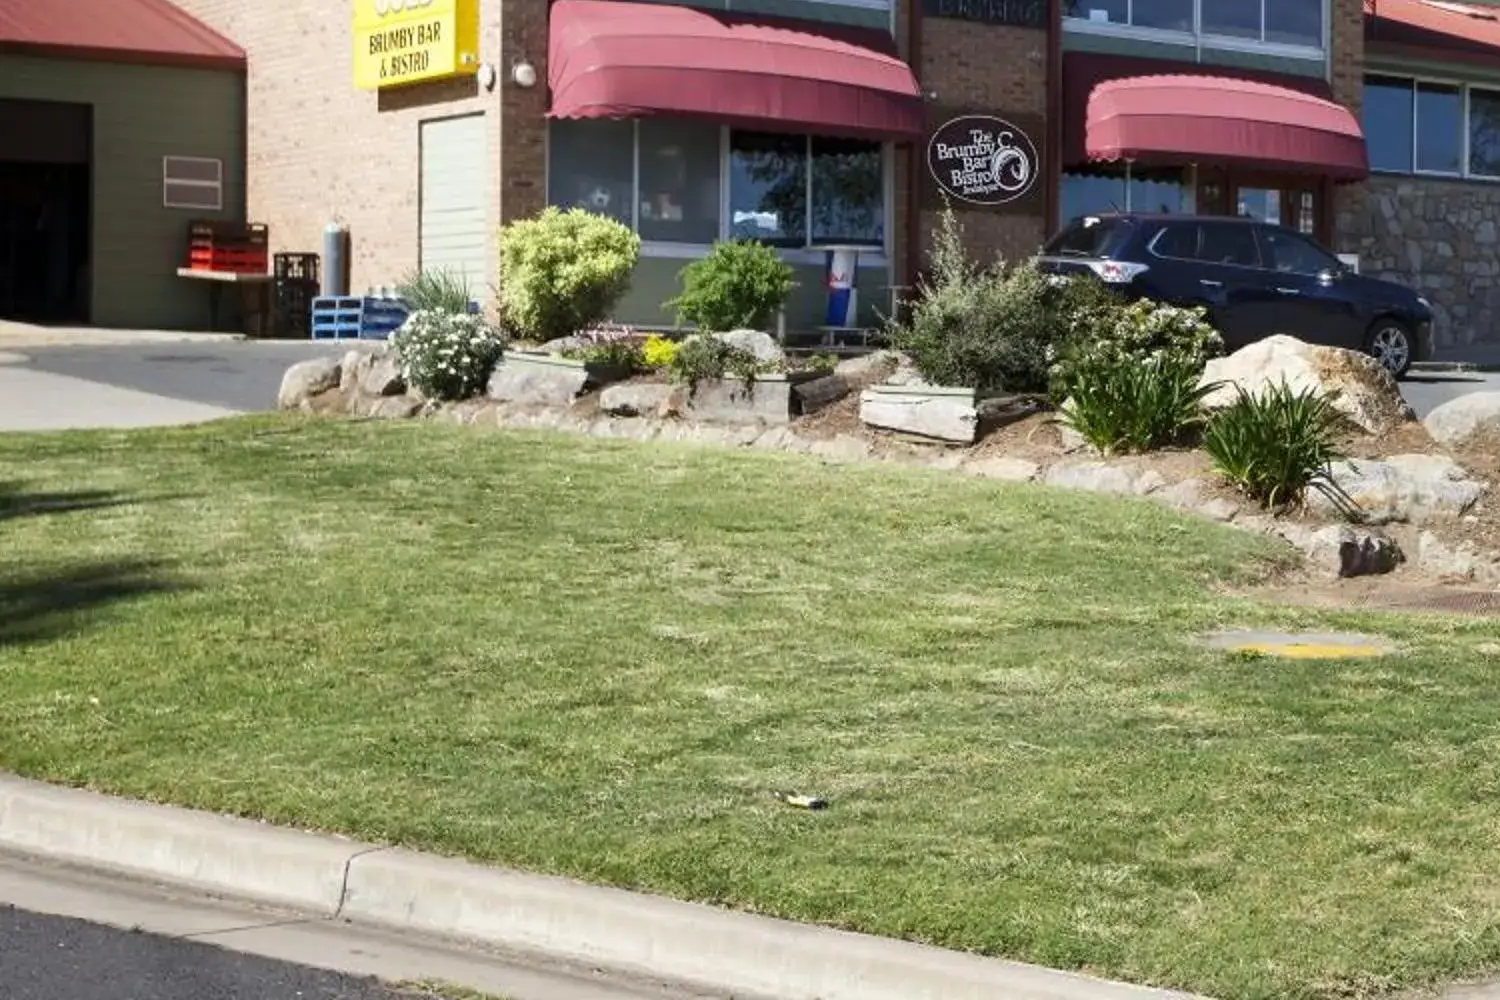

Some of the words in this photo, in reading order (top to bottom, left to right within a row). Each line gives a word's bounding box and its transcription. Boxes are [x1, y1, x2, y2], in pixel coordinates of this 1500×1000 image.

[369, 25, 416, 55] BRUMBY
[417, 20, 442, 44] BAR
[379, 61, 388, 79] &
[389, 50, 430, 77] BISTRO
[969, 129, 993, 144] The
[936, 143, 995, 160] Brumby
[963, 156, 988, 173] Bar
[951, 169, 993, 187] Bistro
